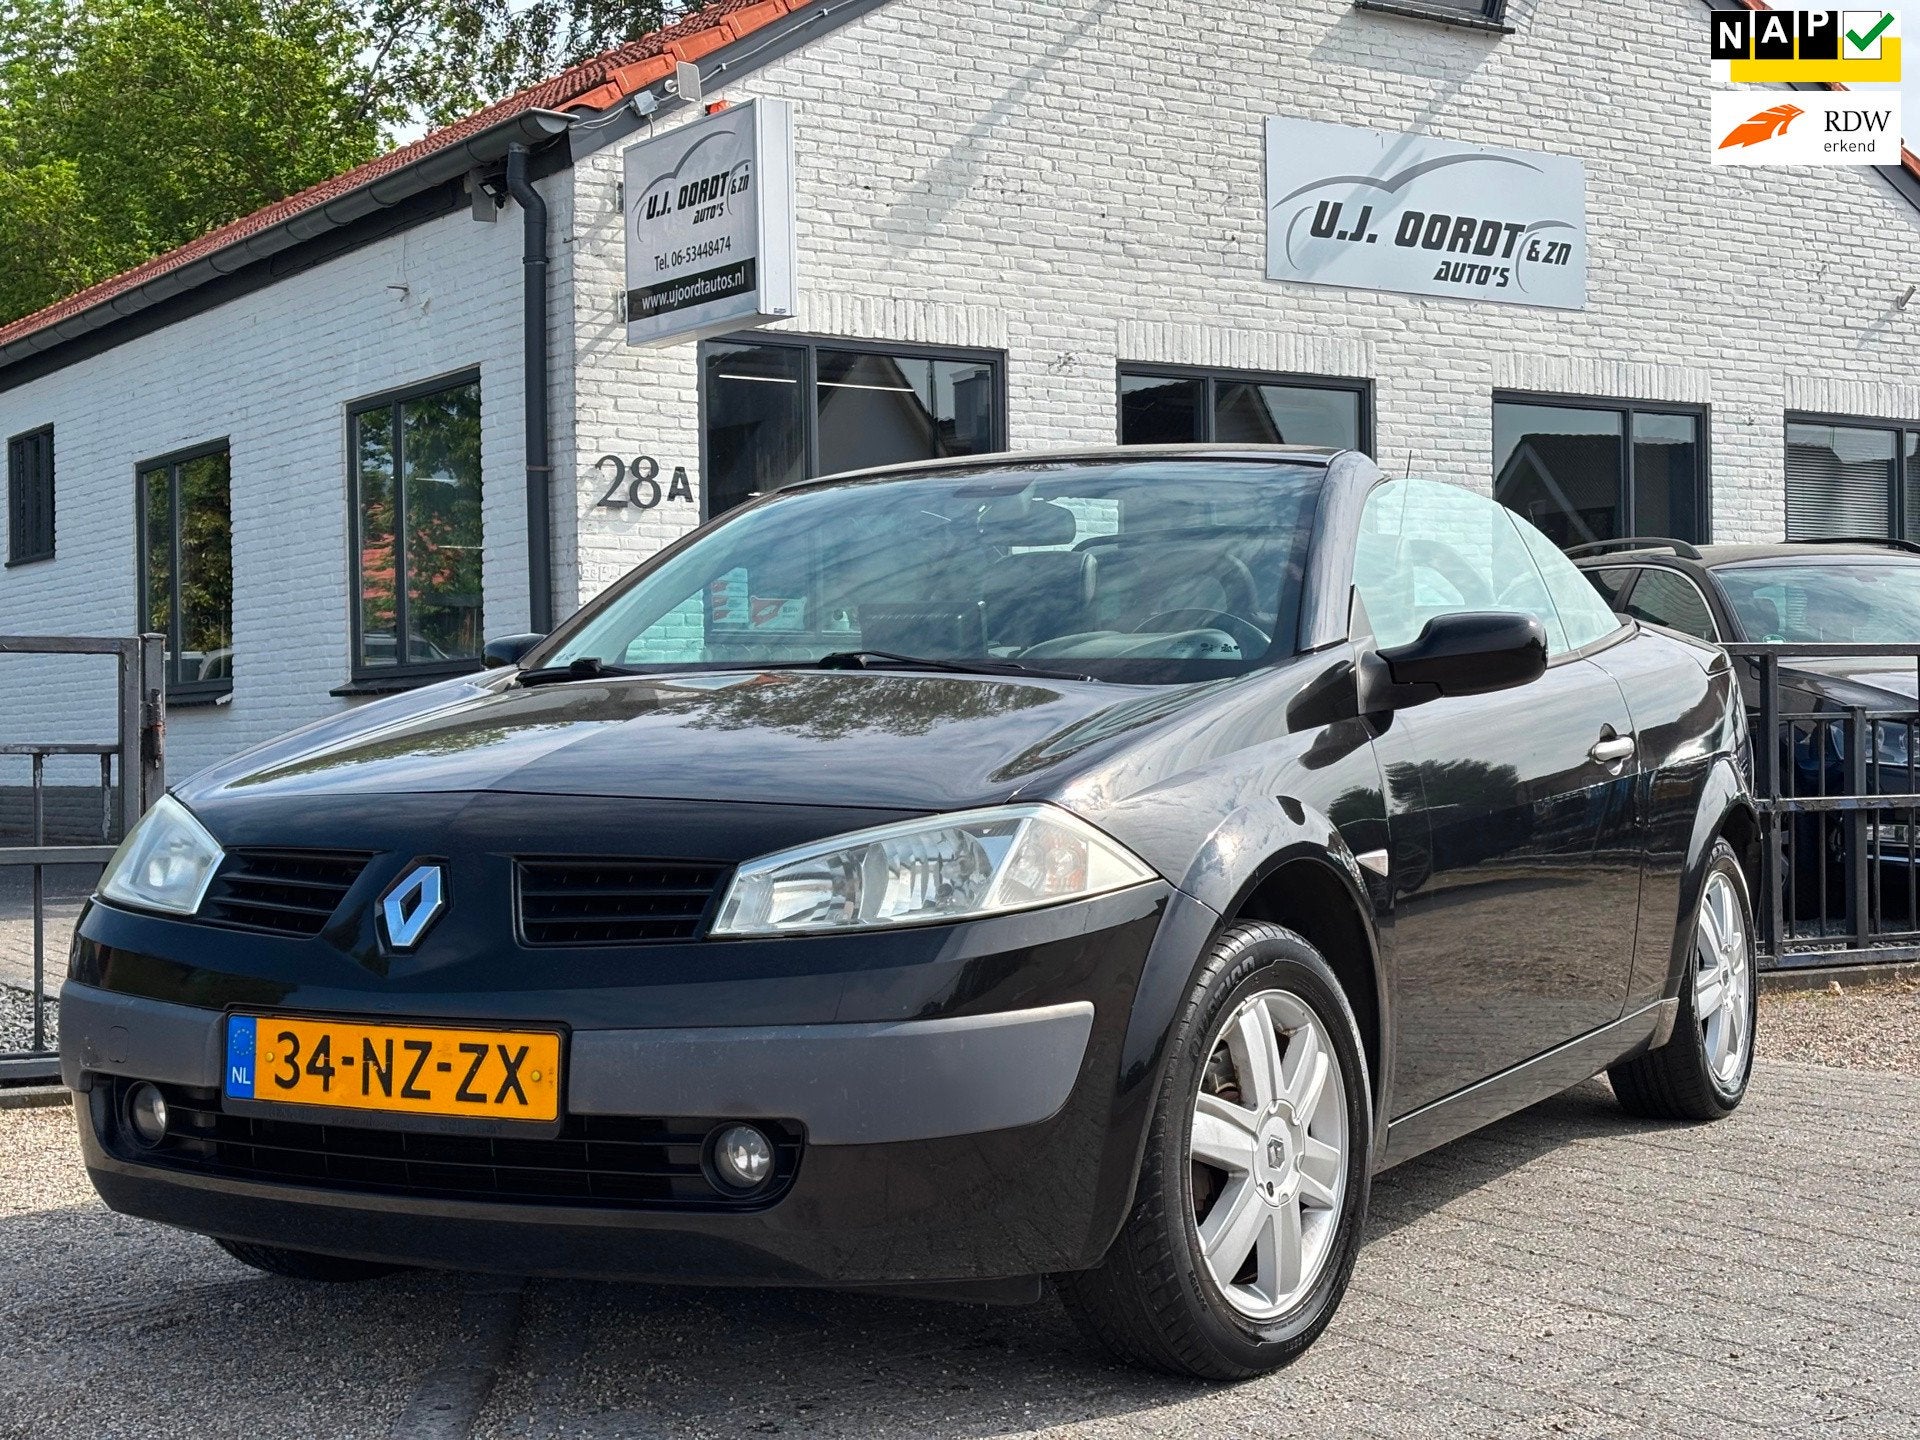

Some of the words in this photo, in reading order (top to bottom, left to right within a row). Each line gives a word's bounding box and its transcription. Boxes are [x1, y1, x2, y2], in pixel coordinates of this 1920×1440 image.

[646, 190, 672, 220] U.J.
[677, 171, 730, 211] OORDT
[1310, 200, 1378, 243] U.J.
[1394, 210, 1527, 259] OORDT
[654, 252, 670, 272] Tel.
[671, 235, 732, 267] 06-53448474
[1433, 260, 1511, 288] AUTO'S
[641, 266, 745, 310] www.ujoordtautos.nl
[231, 1066, 251, 1086] NL
[274, 1031, 530, 1106] 34-NZ-ZX
